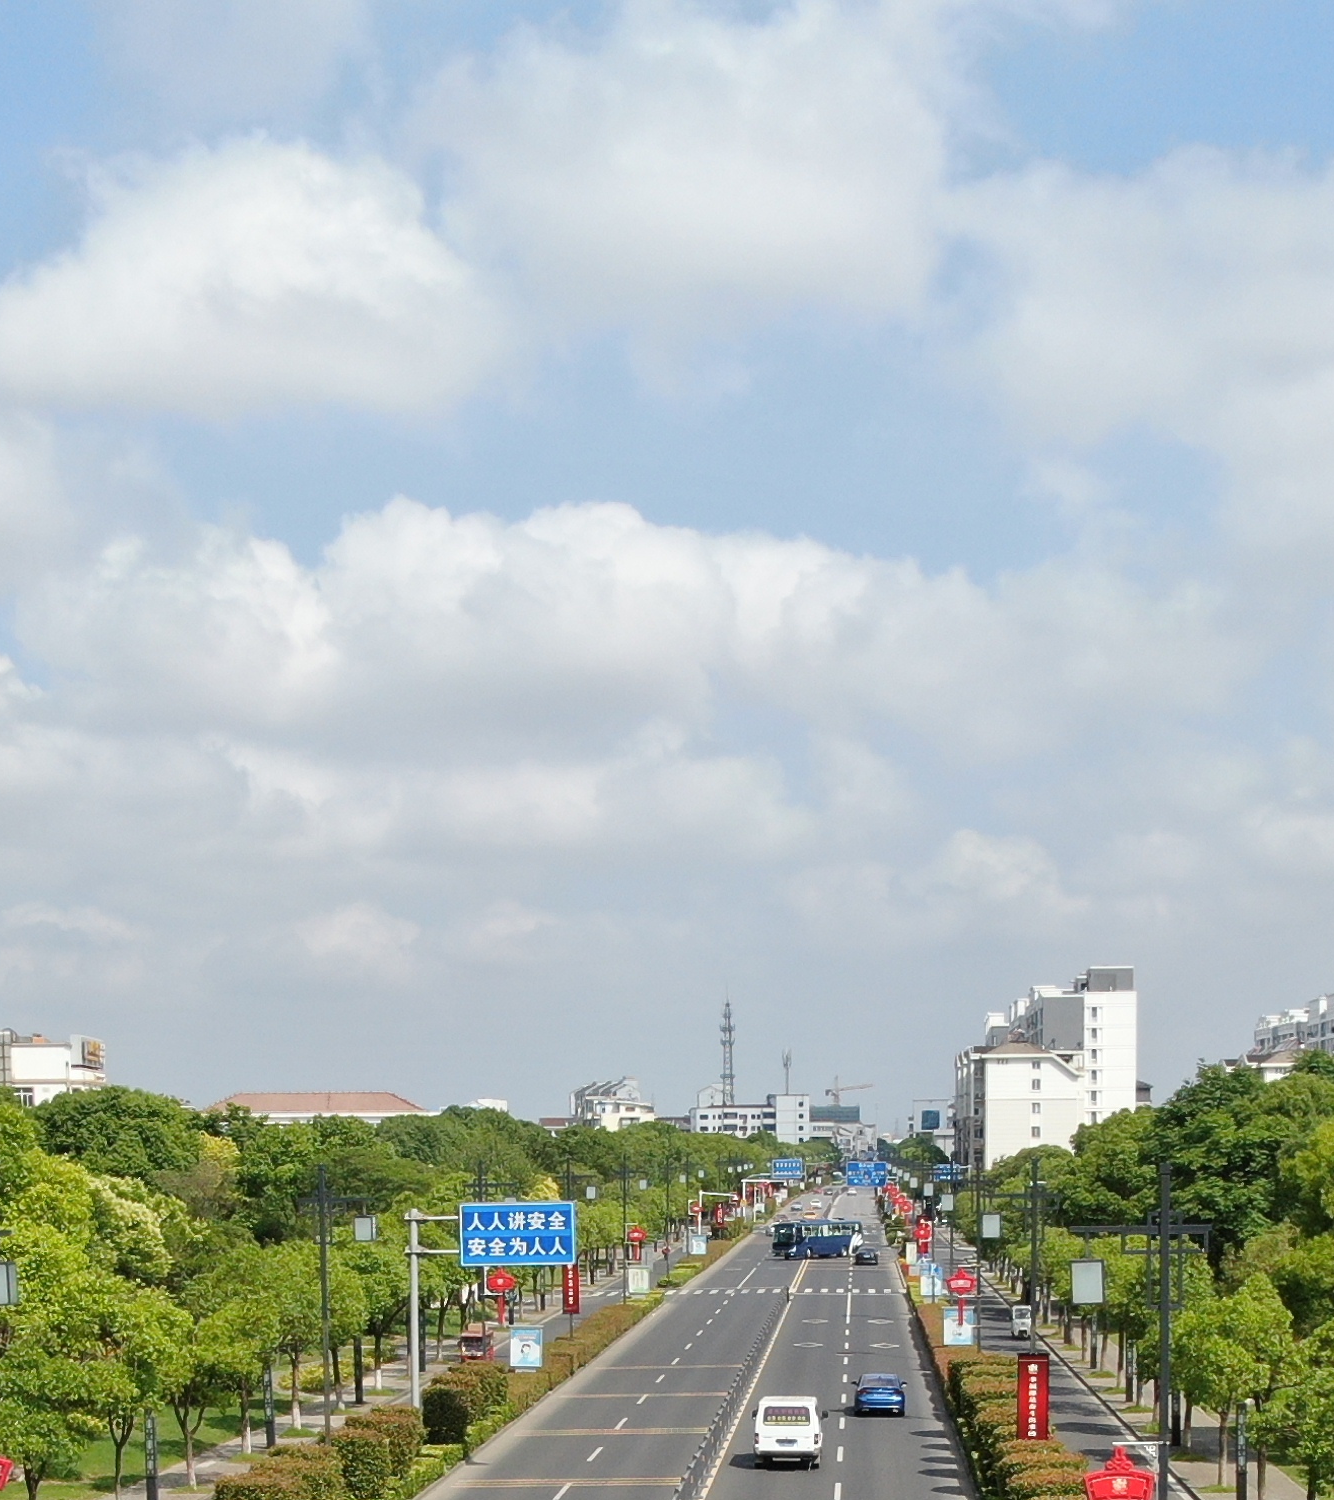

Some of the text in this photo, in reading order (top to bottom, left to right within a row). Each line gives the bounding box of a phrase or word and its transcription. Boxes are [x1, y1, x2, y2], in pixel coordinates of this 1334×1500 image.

[467, 1211, 566, 1231] 人人讲安全
[467, 1236, 567, 1257] 安全为人人
